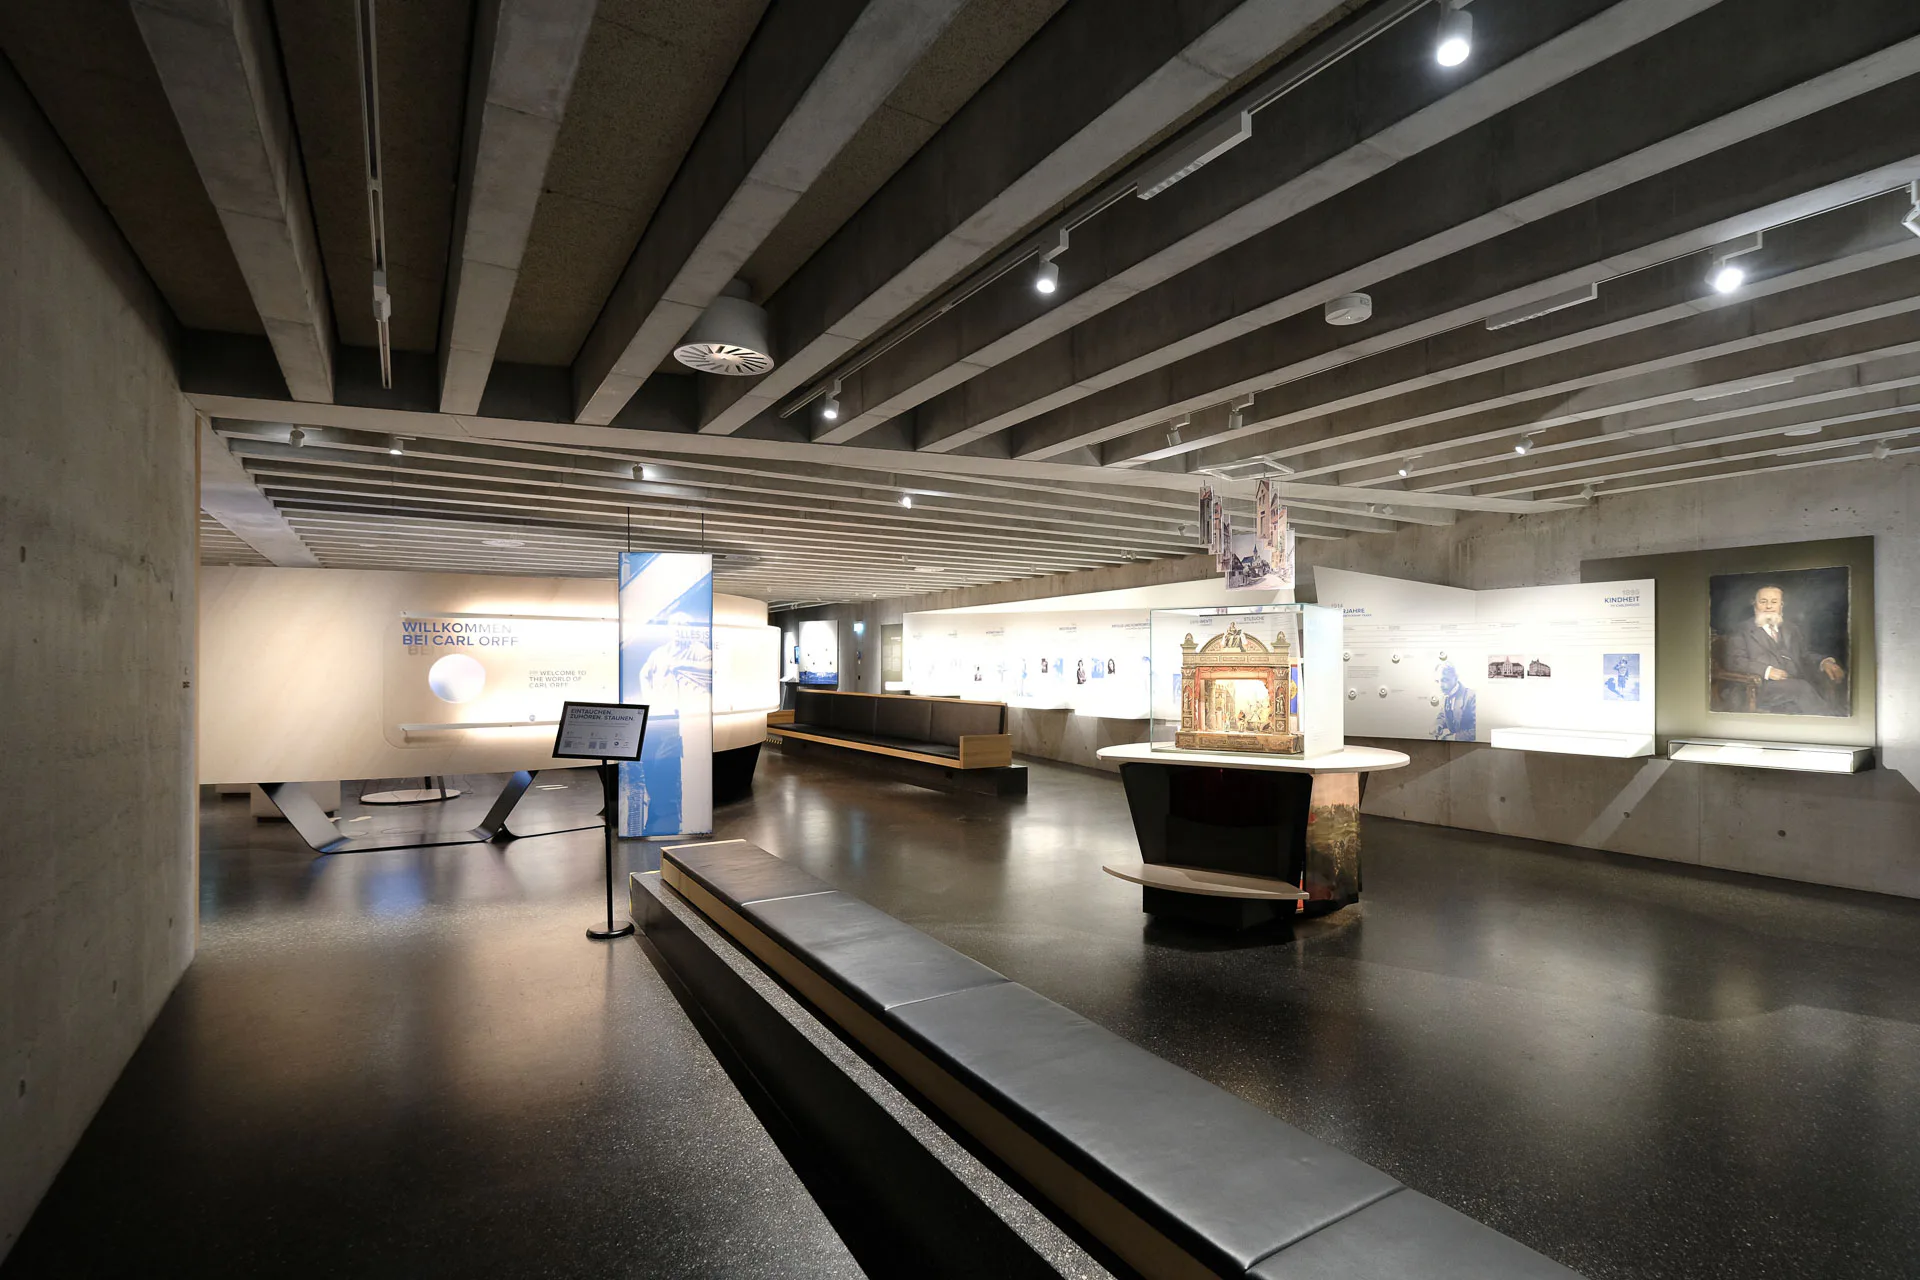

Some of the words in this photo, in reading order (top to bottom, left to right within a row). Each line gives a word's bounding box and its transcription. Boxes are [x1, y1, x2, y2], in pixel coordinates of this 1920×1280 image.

[402, 621, 512, 634] WILLKOMMEN
[402, 634, 428, 646] BEI
[432, 635, 474, 646] CARL
[478, 636, 518, 647] ORFF
